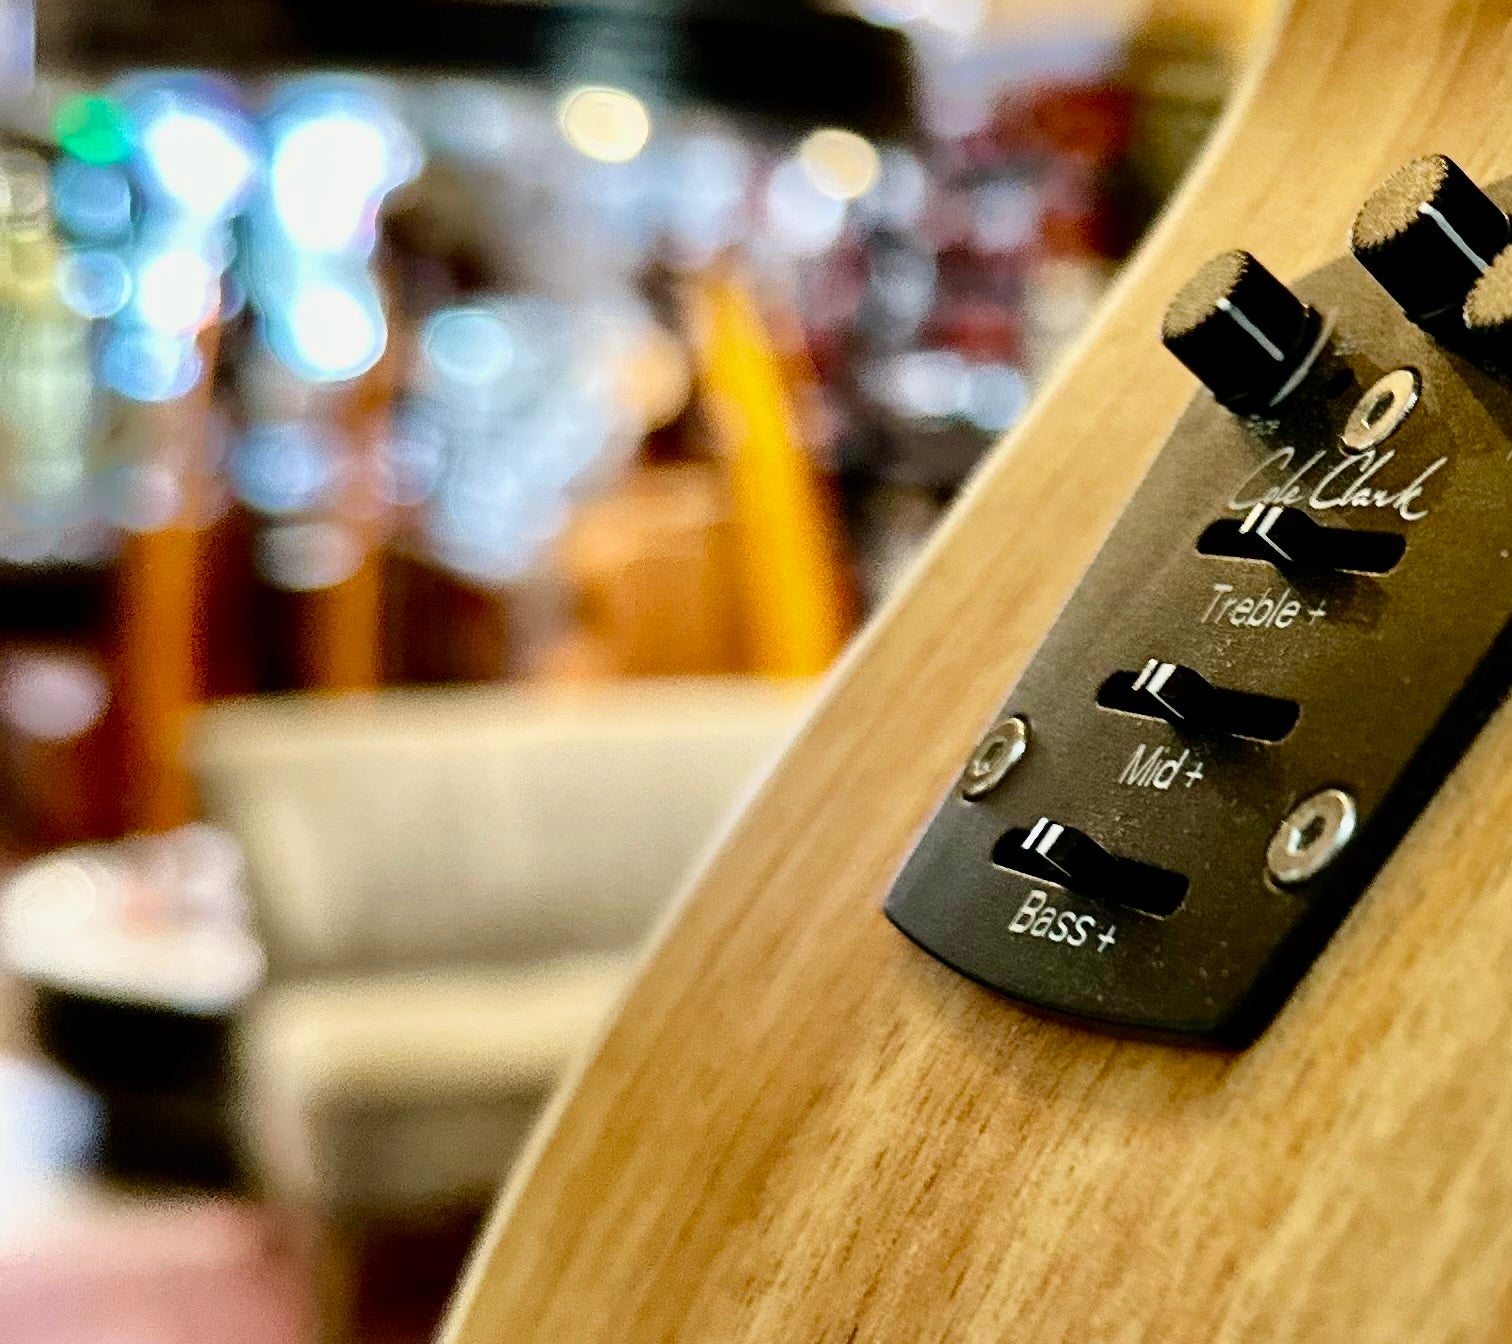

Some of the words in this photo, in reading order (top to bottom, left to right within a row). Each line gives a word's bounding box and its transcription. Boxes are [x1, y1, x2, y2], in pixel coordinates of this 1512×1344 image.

[1308, 448, 1448, 522] Clark
[1200, 582, 1302, 629] Treble
[1117, 742, 1191, 791] Mid
[1007, 888, 1098, 948] Bass
